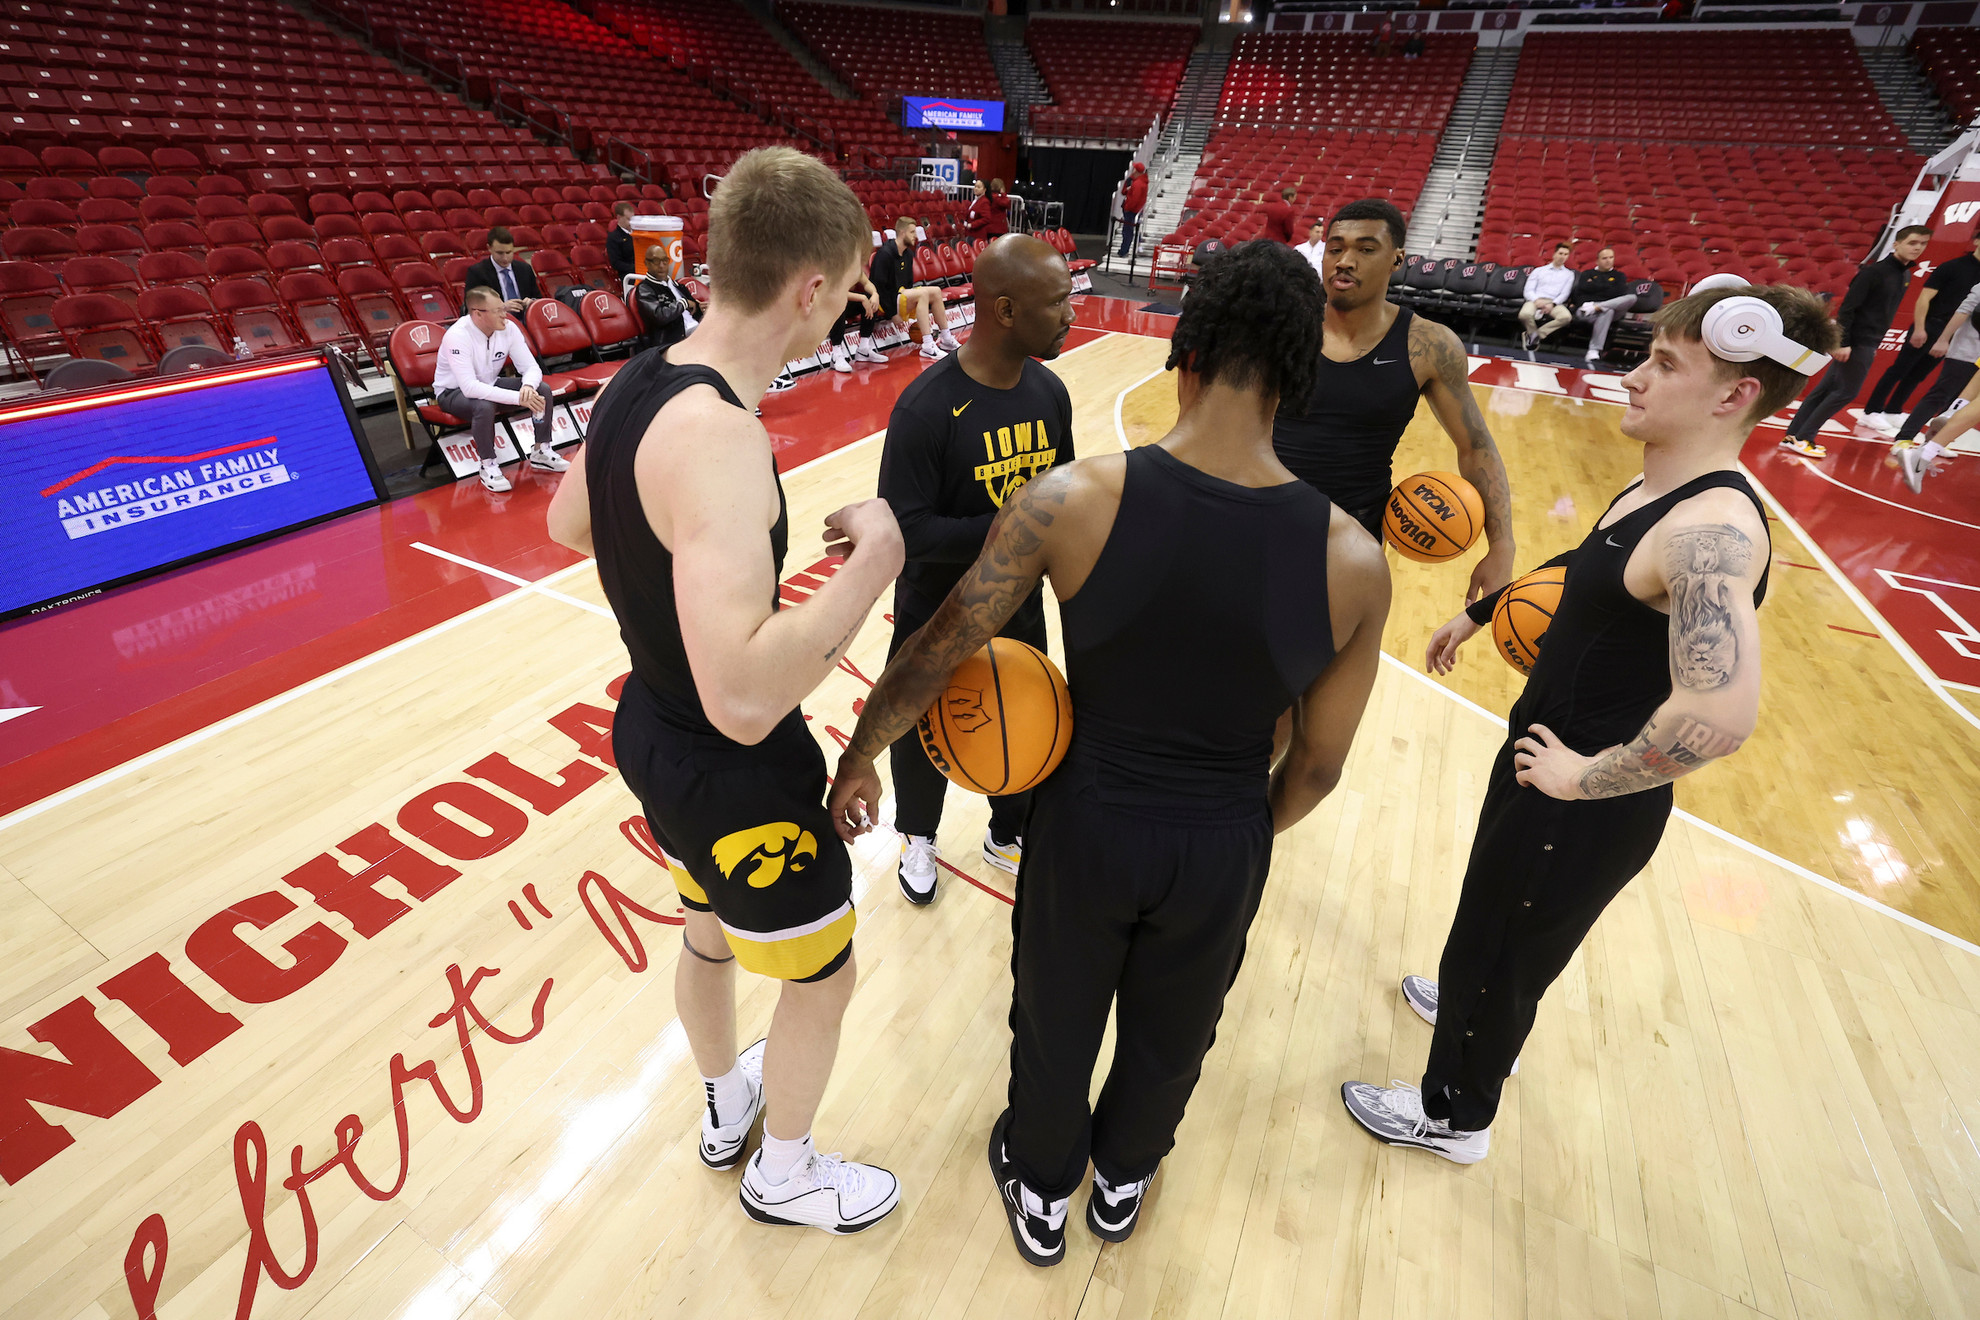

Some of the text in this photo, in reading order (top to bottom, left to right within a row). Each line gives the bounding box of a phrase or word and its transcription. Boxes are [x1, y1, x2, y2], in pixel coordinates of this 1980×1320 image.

[922, 110, 984, 120] AMERICAN FAMILY
[669, 240, 683, 263] G
[983, 420, 1049, 462] IOWA
[57, 447, 280, 519] AMERICAN FAMILY
[980, 451, 1054, 477] BASKETBALL
[85, 472, 274, 530] INSURANCE
[1413, 484, 1456, 521] NCAA
[1390, 496, 1437, 550] Wilson
[0, 671, 632, 1186] NICHOLA
